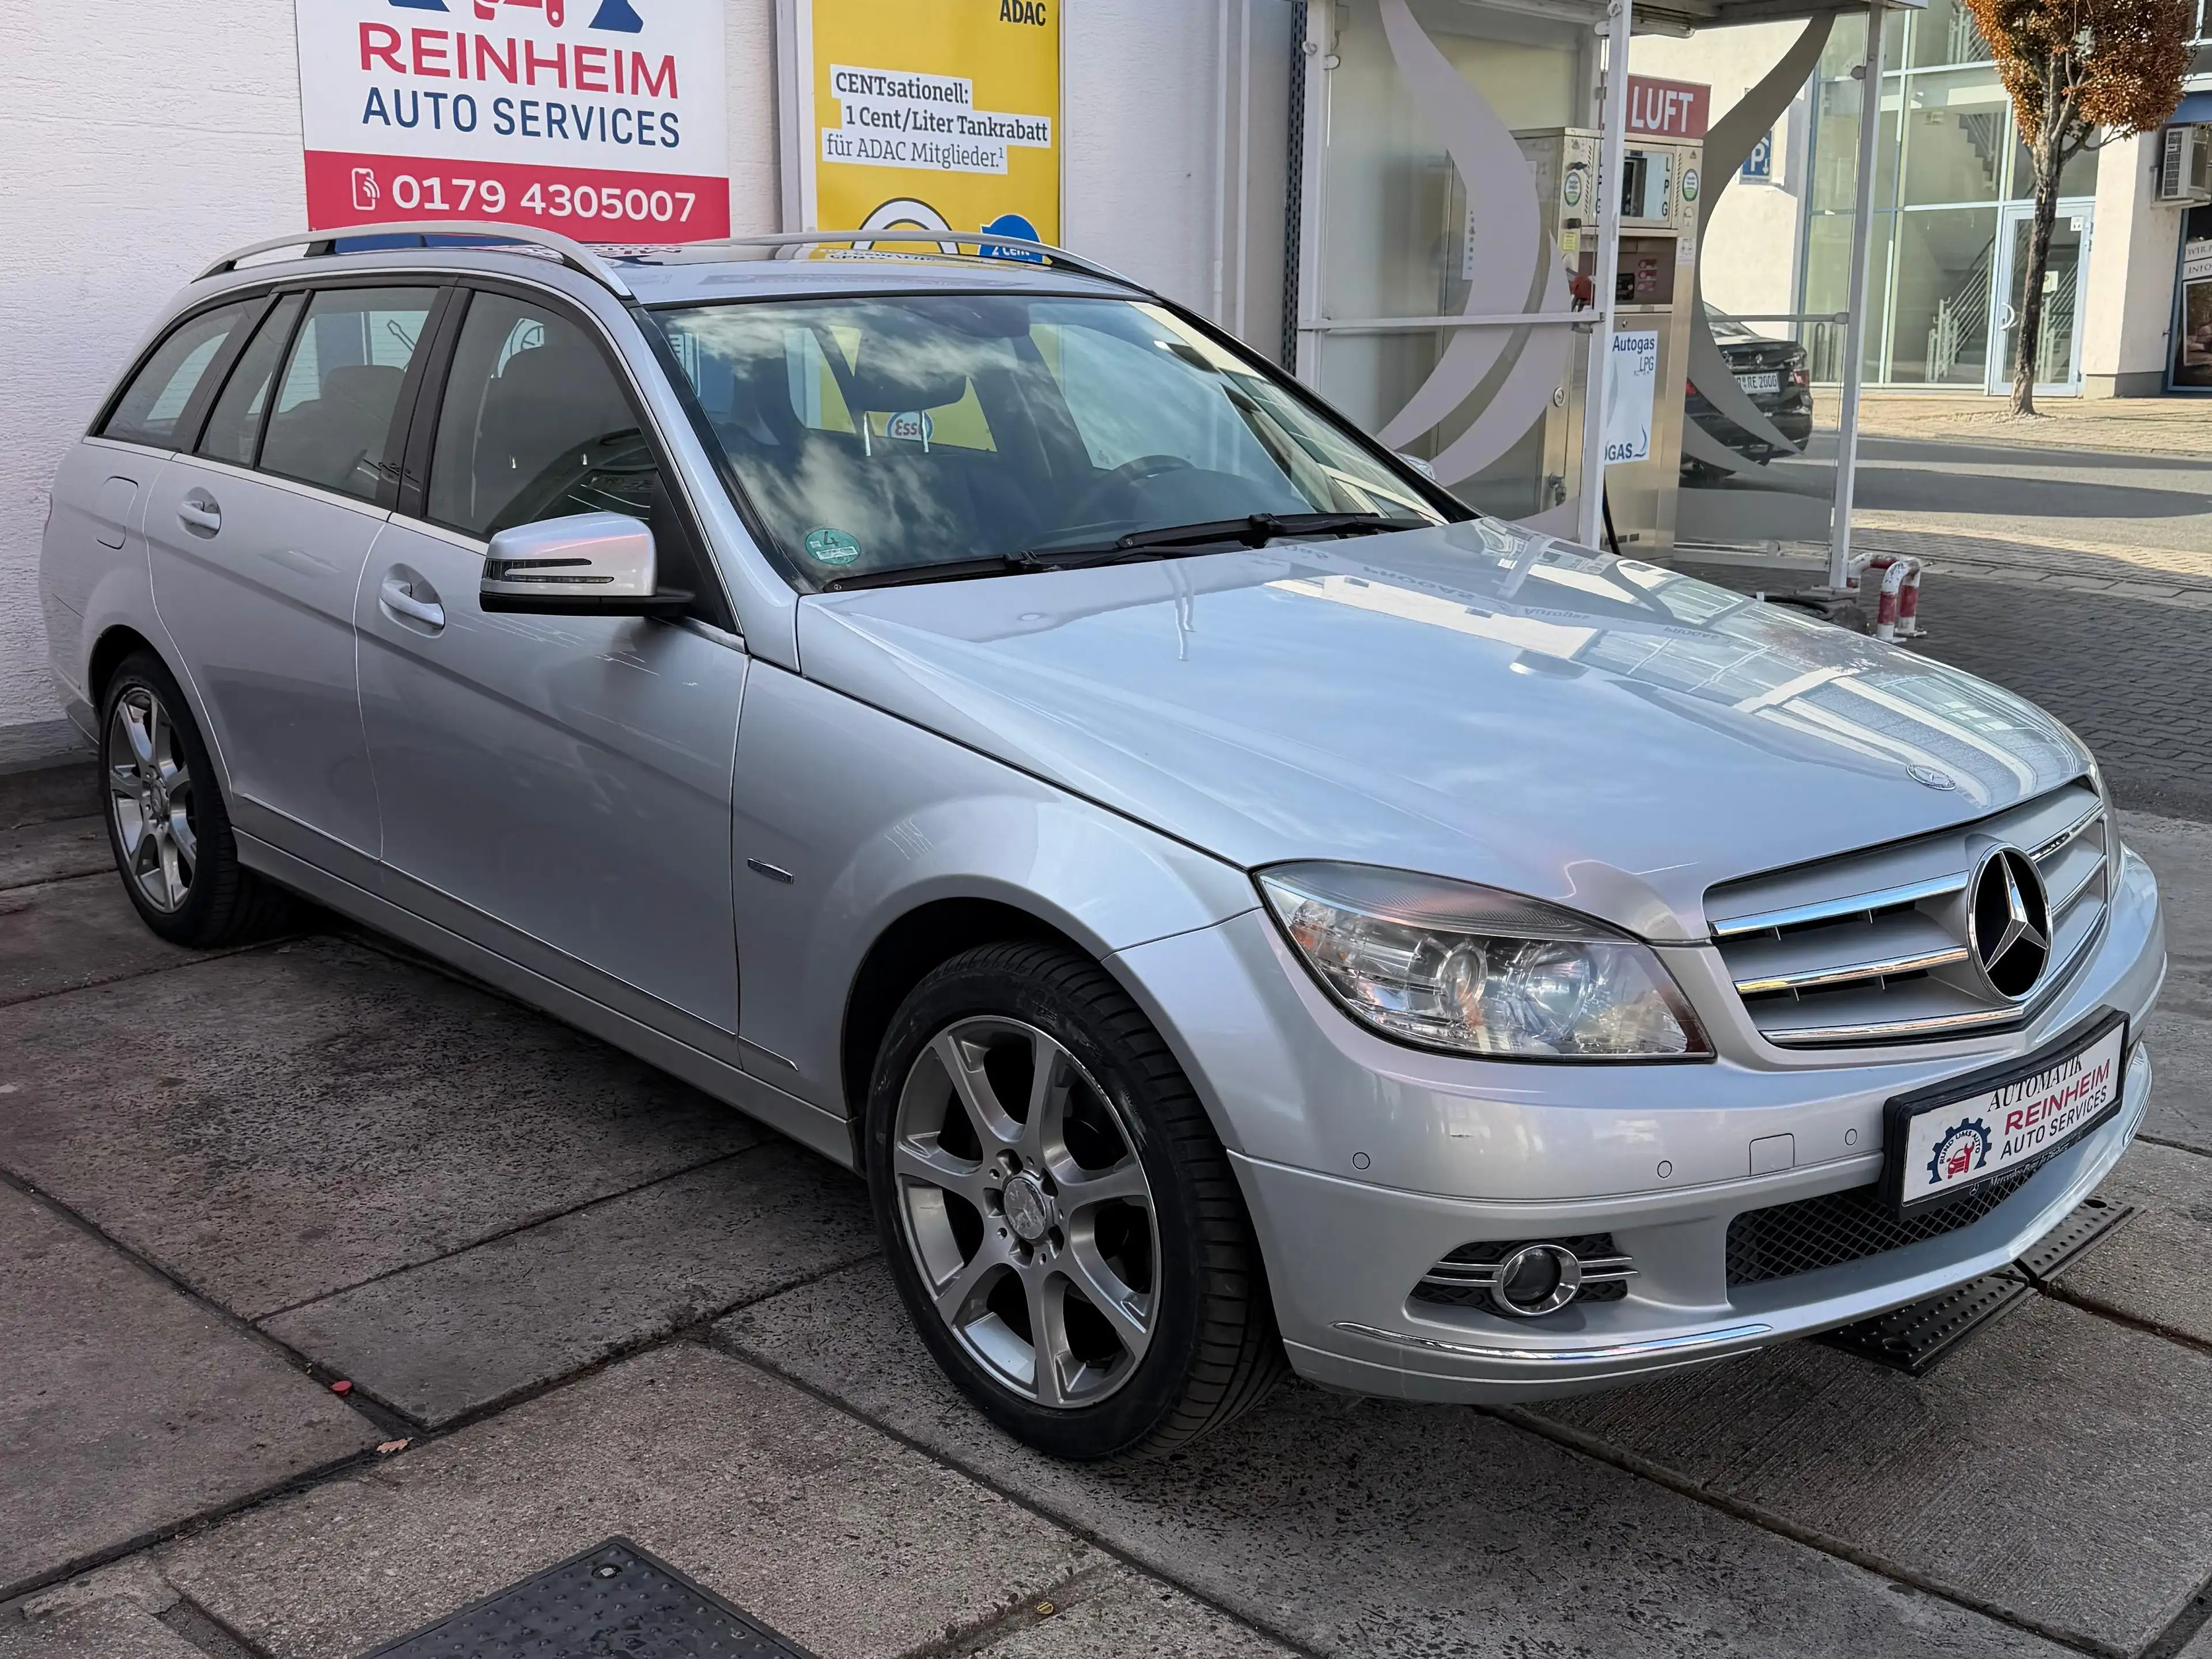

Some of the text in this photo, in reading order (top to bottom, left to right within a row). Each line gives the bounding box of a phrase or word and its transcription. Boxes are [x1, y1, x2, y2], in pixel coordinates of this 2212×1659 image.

[999, 0, 1046, 26] ADAC
[358, 22, 679, 99] REINHEIM
[836, 72, 969, 104] CENTsationell:
[362, 87, 680, 148] AUTO SERVICES
[846, 105, 1047, 142] 1 Cent/Liter Tankrabatt
[1631, 86, 1694, 132] LUFT
[827, 133, 853, 157] für
[857, 138, 906, 161] ADAC
[392, 175, 696, 222] 0179 4305007
[1612, 335, 1655, 354] Autogas
[1639, 356, 1654, 372] LPG
[1759, 375, 1777, 388] 2000
[823, 531, 839, 547] 4
[1987, 1054, 2082, 1112] AUTOMATIK
[2005, 1058, 2111, 1135] REINHEIM
[2000, 1085, 2107, 1161] AUTO SERVICES
[1971, 1133, 1981, 1154] AUTO
